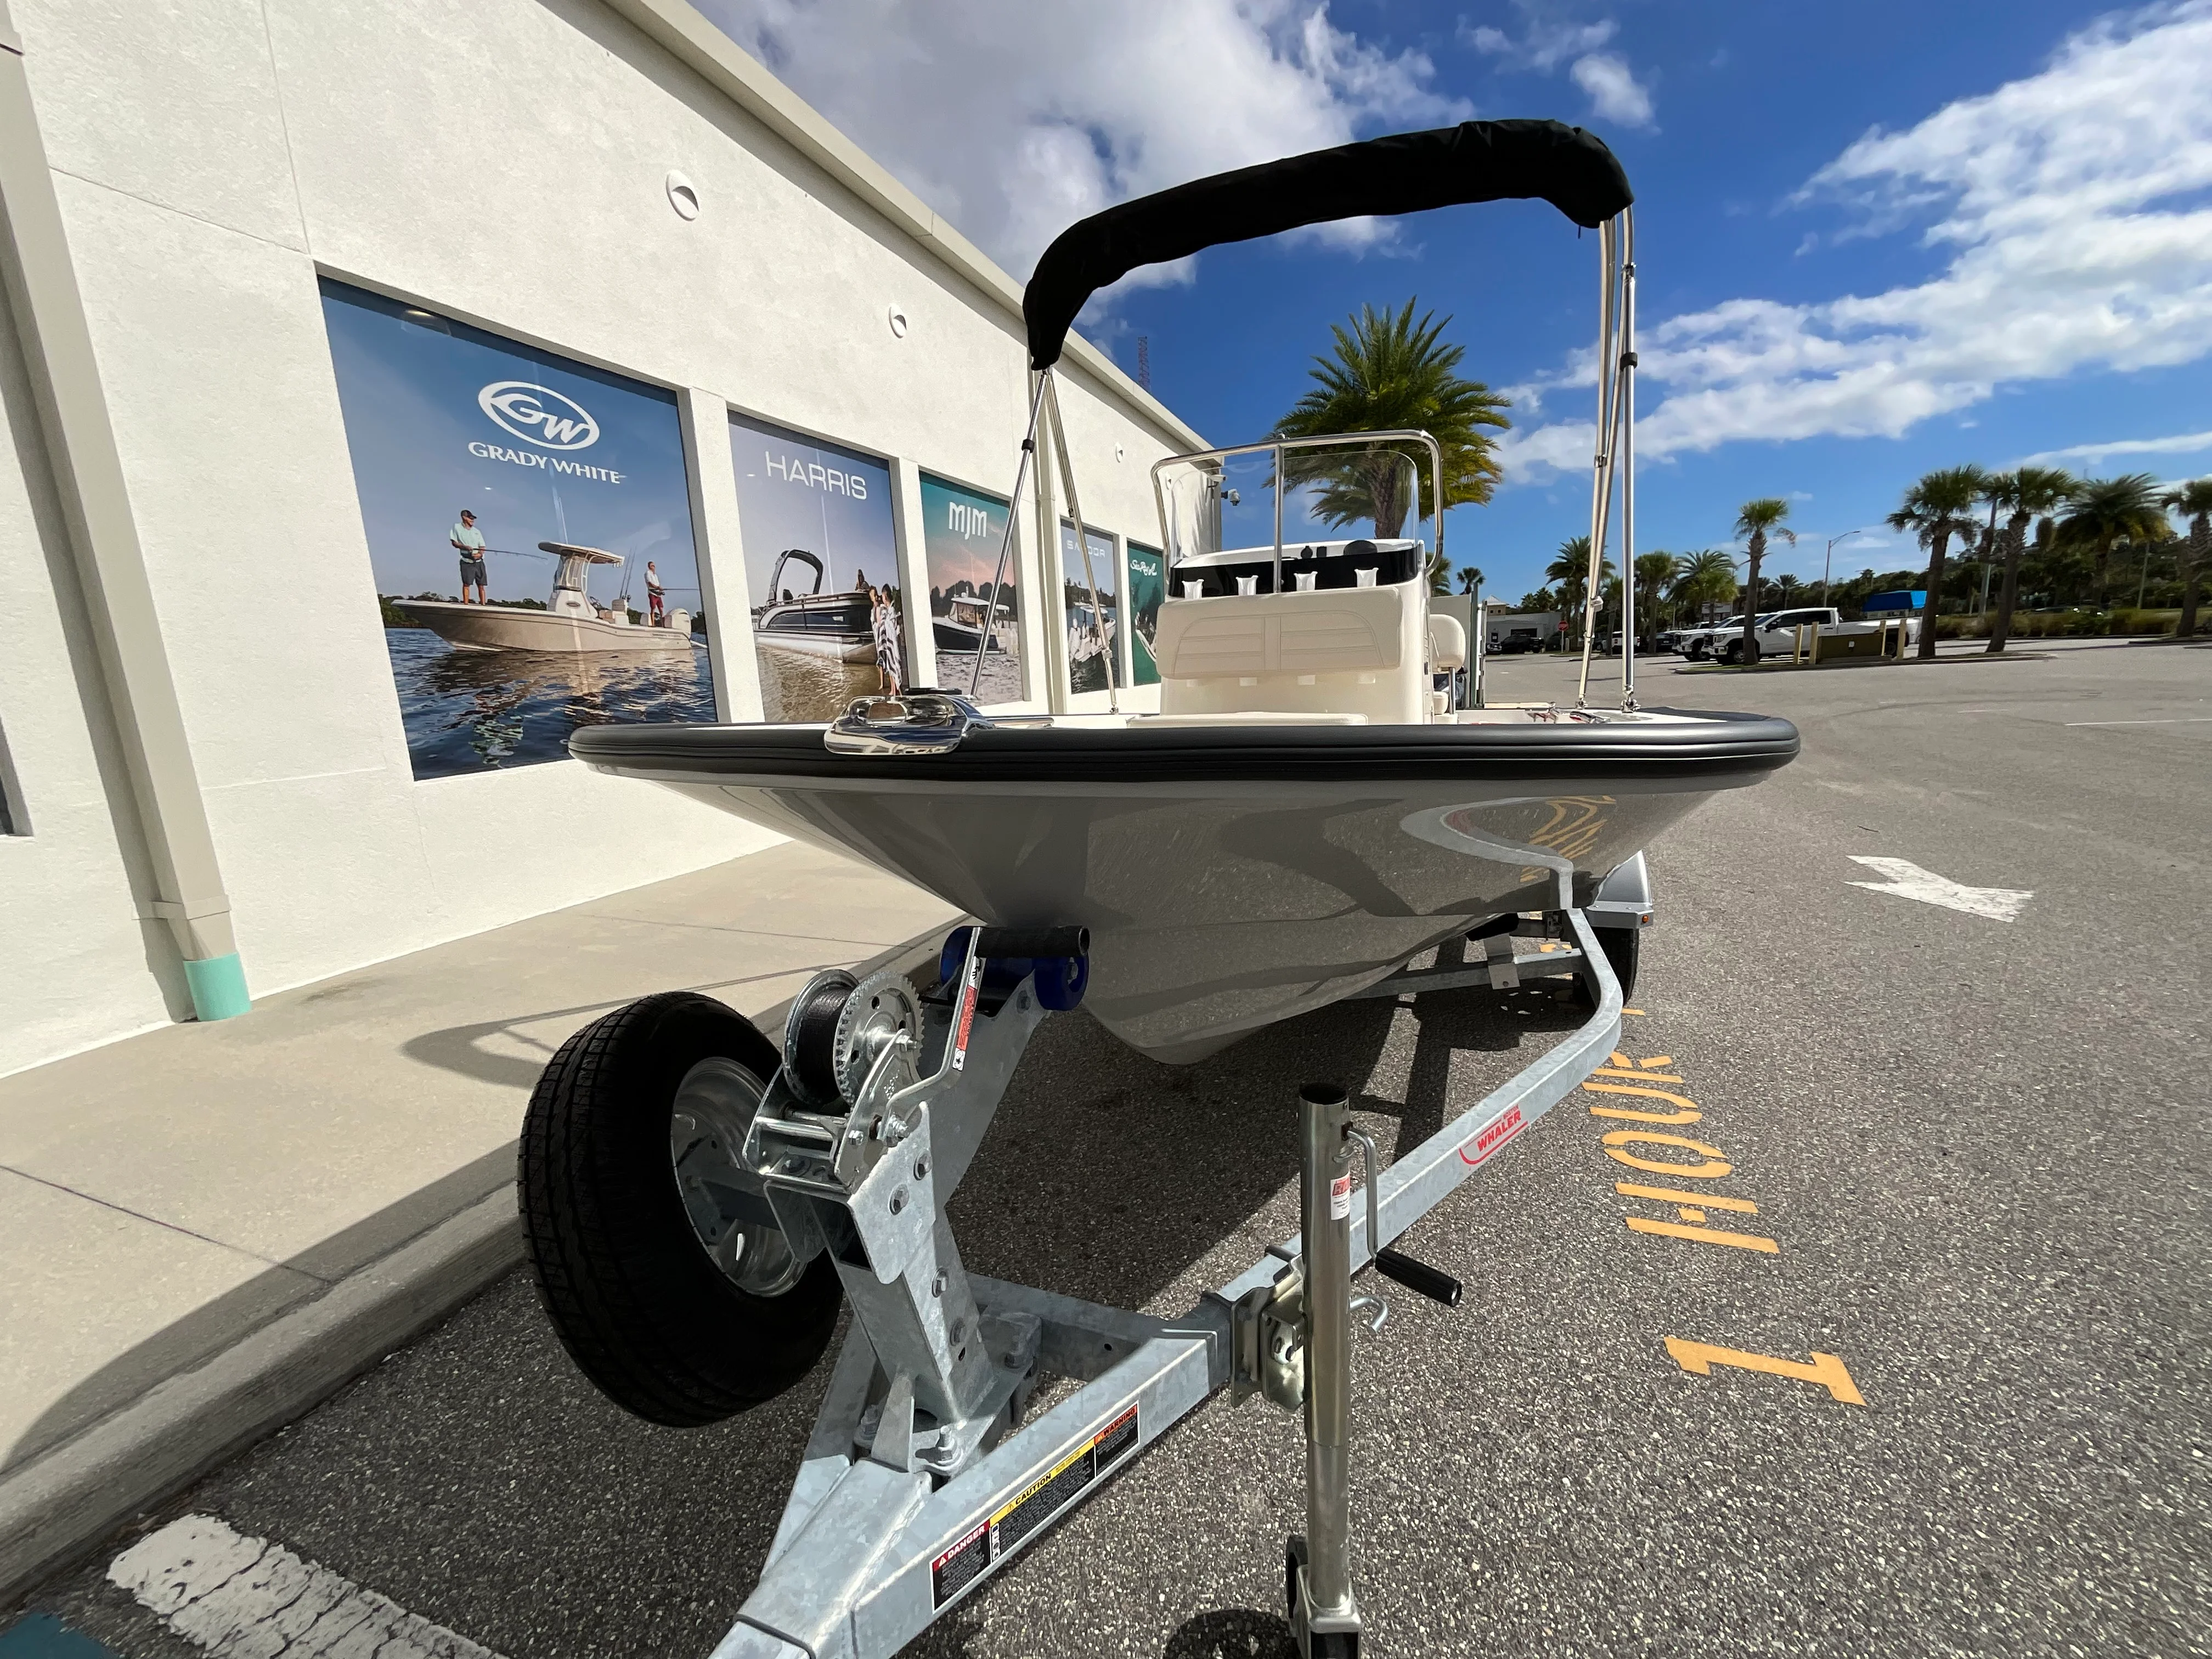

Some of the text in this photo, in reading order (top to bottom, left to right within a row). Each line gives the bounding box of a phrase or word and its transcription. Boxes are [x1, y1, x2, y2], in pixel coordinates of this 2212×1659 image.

[469, 442, 620, 484] GRADY WHITE
[765, 450, 867, 500] HARRIS
[1477, 1110, 1521, 1152] WHALER
[1664, 1336, 1866, 1406] 1
[1103, 1408, 1136, 1436] WARNING
[1015, 1473, 1052, 1505] CAUTION
[947, 1525, 985, 1559] DANGER
